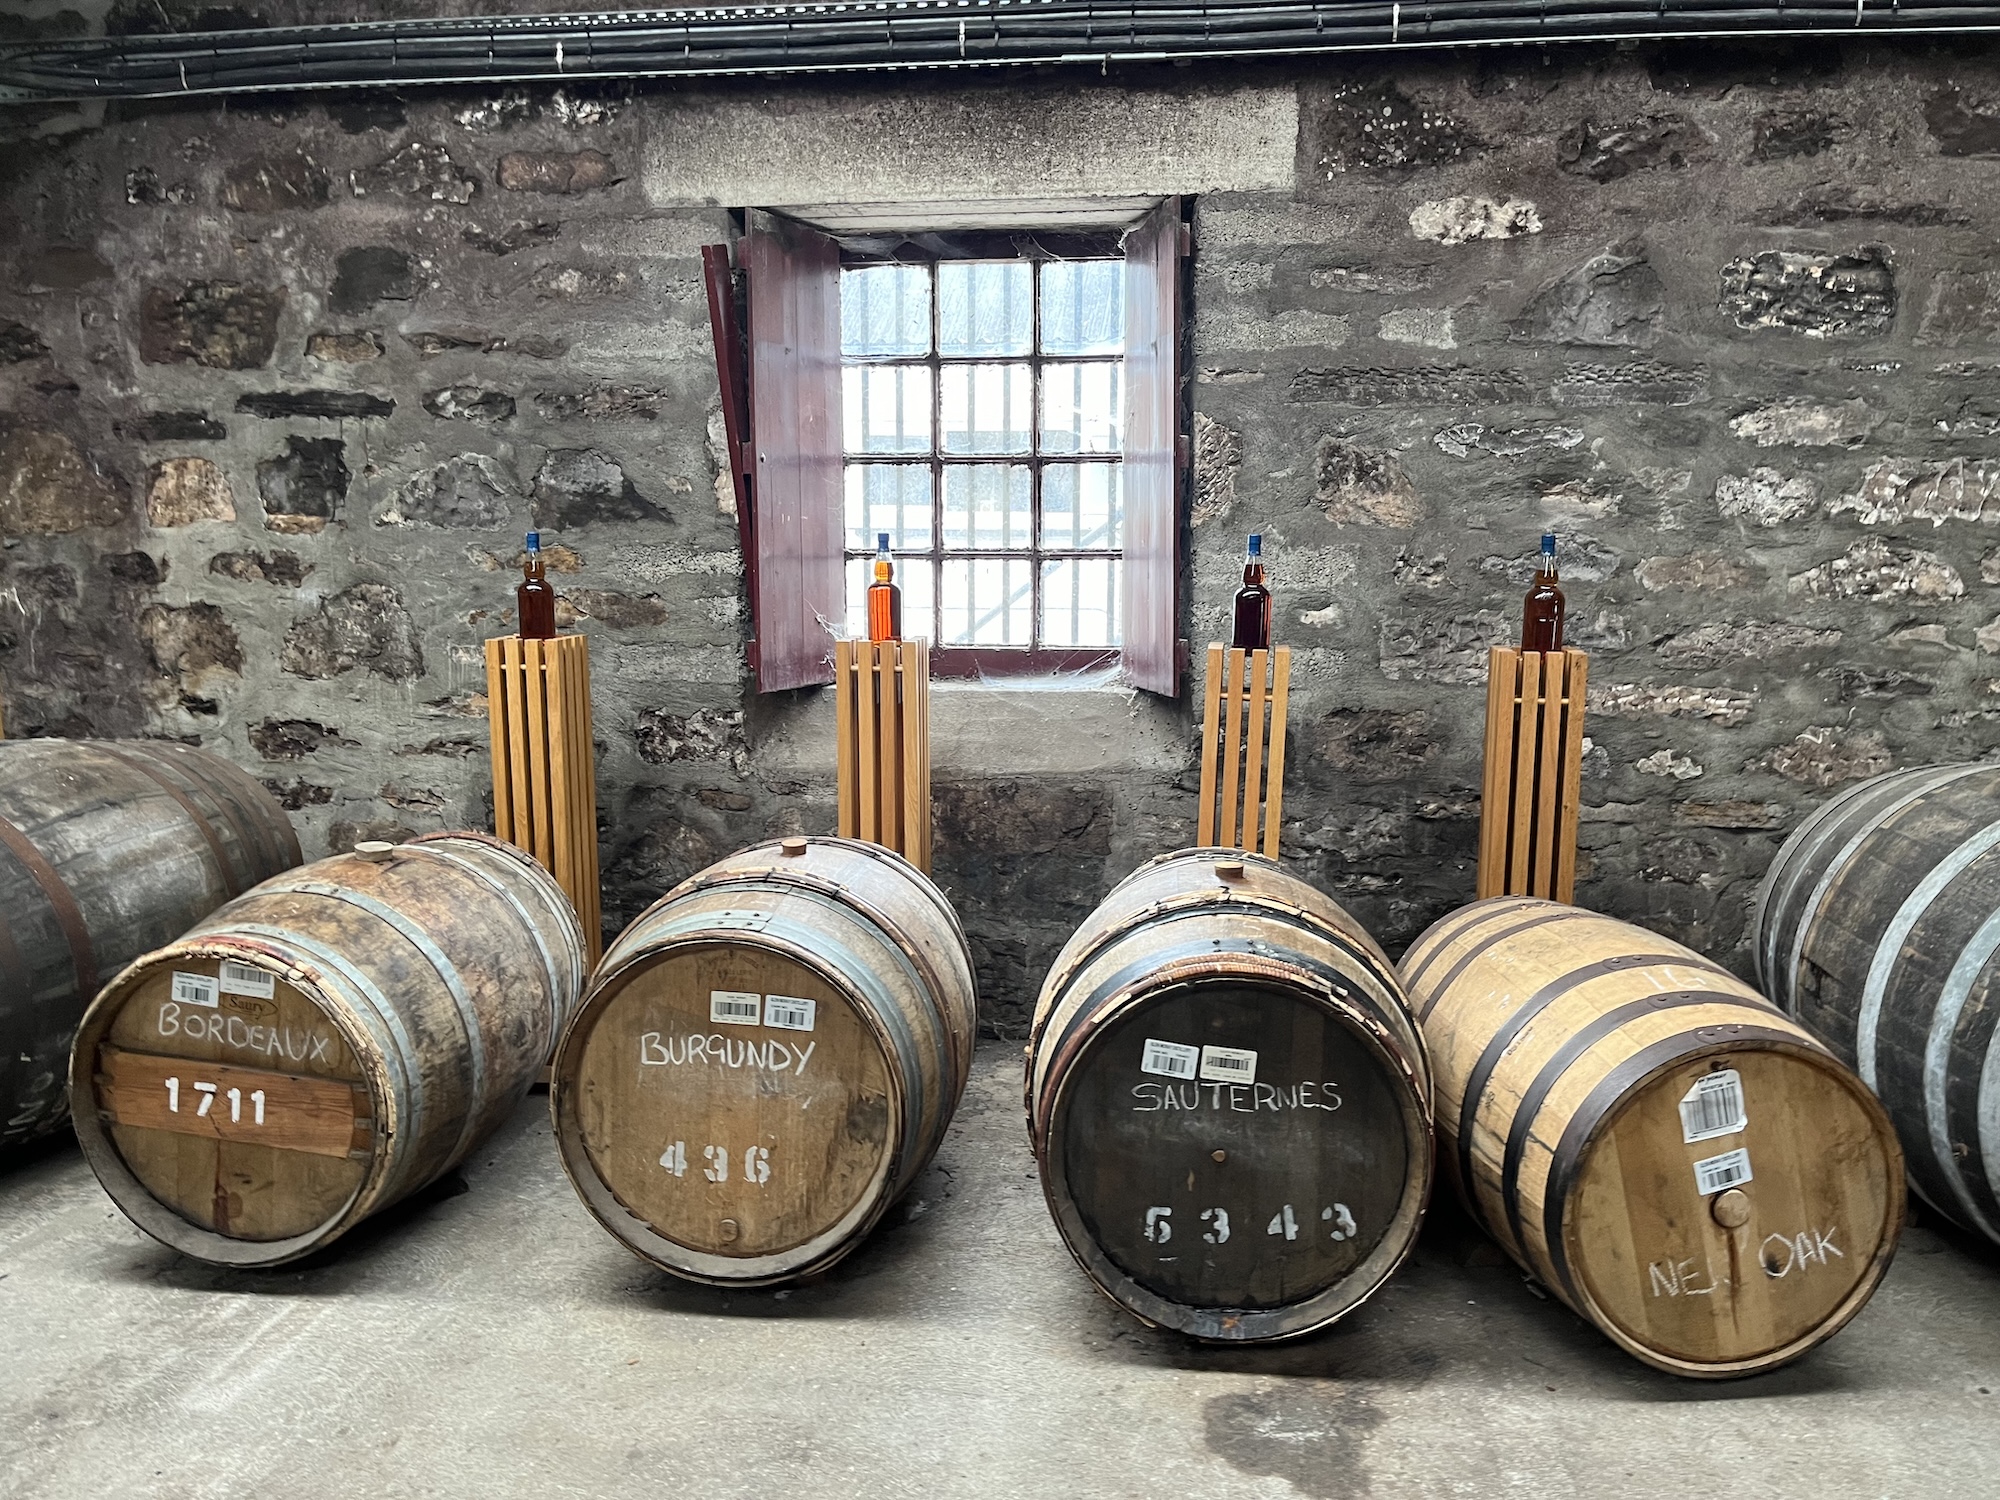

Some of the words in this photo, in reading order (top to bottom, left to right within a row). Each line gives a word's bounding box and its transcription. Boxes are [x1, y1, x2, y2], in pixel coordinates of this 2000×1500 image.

[157, 1003, 329, 1063] BORDEAUX
[640, 1032, 816, 1076] BURGUNDY
[165, 1077, 266, 1125] 1711
[1131, 1081, 1342, 1112] SAUTERNES
[659, 1141, 771, 1187] 436
[1649, 1255, 1732, 1297] NE
[1758, 1226, 1844, 1279] OAK
